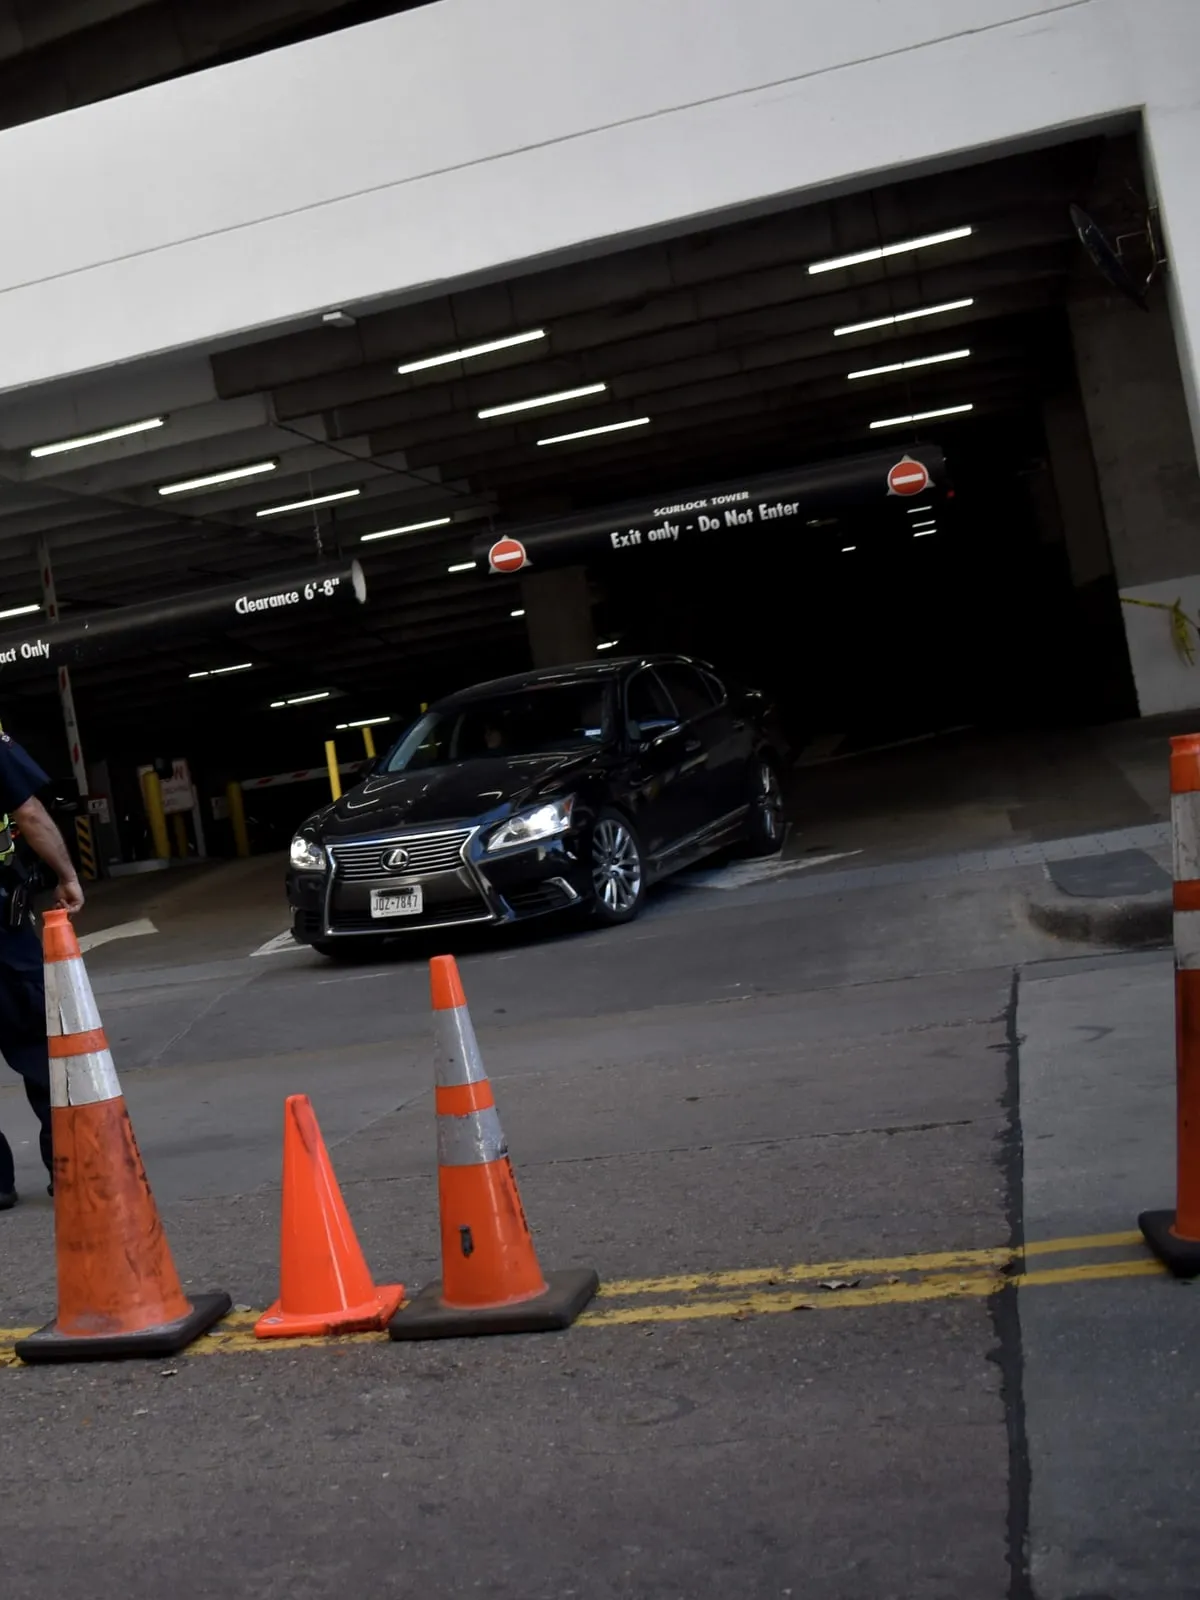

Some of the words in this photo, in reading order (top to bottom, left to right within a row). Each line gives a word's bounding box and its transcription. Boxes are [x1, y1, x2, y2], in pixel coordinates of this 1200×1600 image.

[653, 499, 708, 517] SCURLOCK
[711, 491, 749, 506] TOWER
[610, 529, 642, 549] Exit
[648, 521, 680, 541] only
[698, 515, 720, 532] Do
[724, 508, 754, 527] Not
[758, 502, 800, 521] Enter
[235, 591, 300, 614] Clearance
[20, 639, 50, 659] Only
